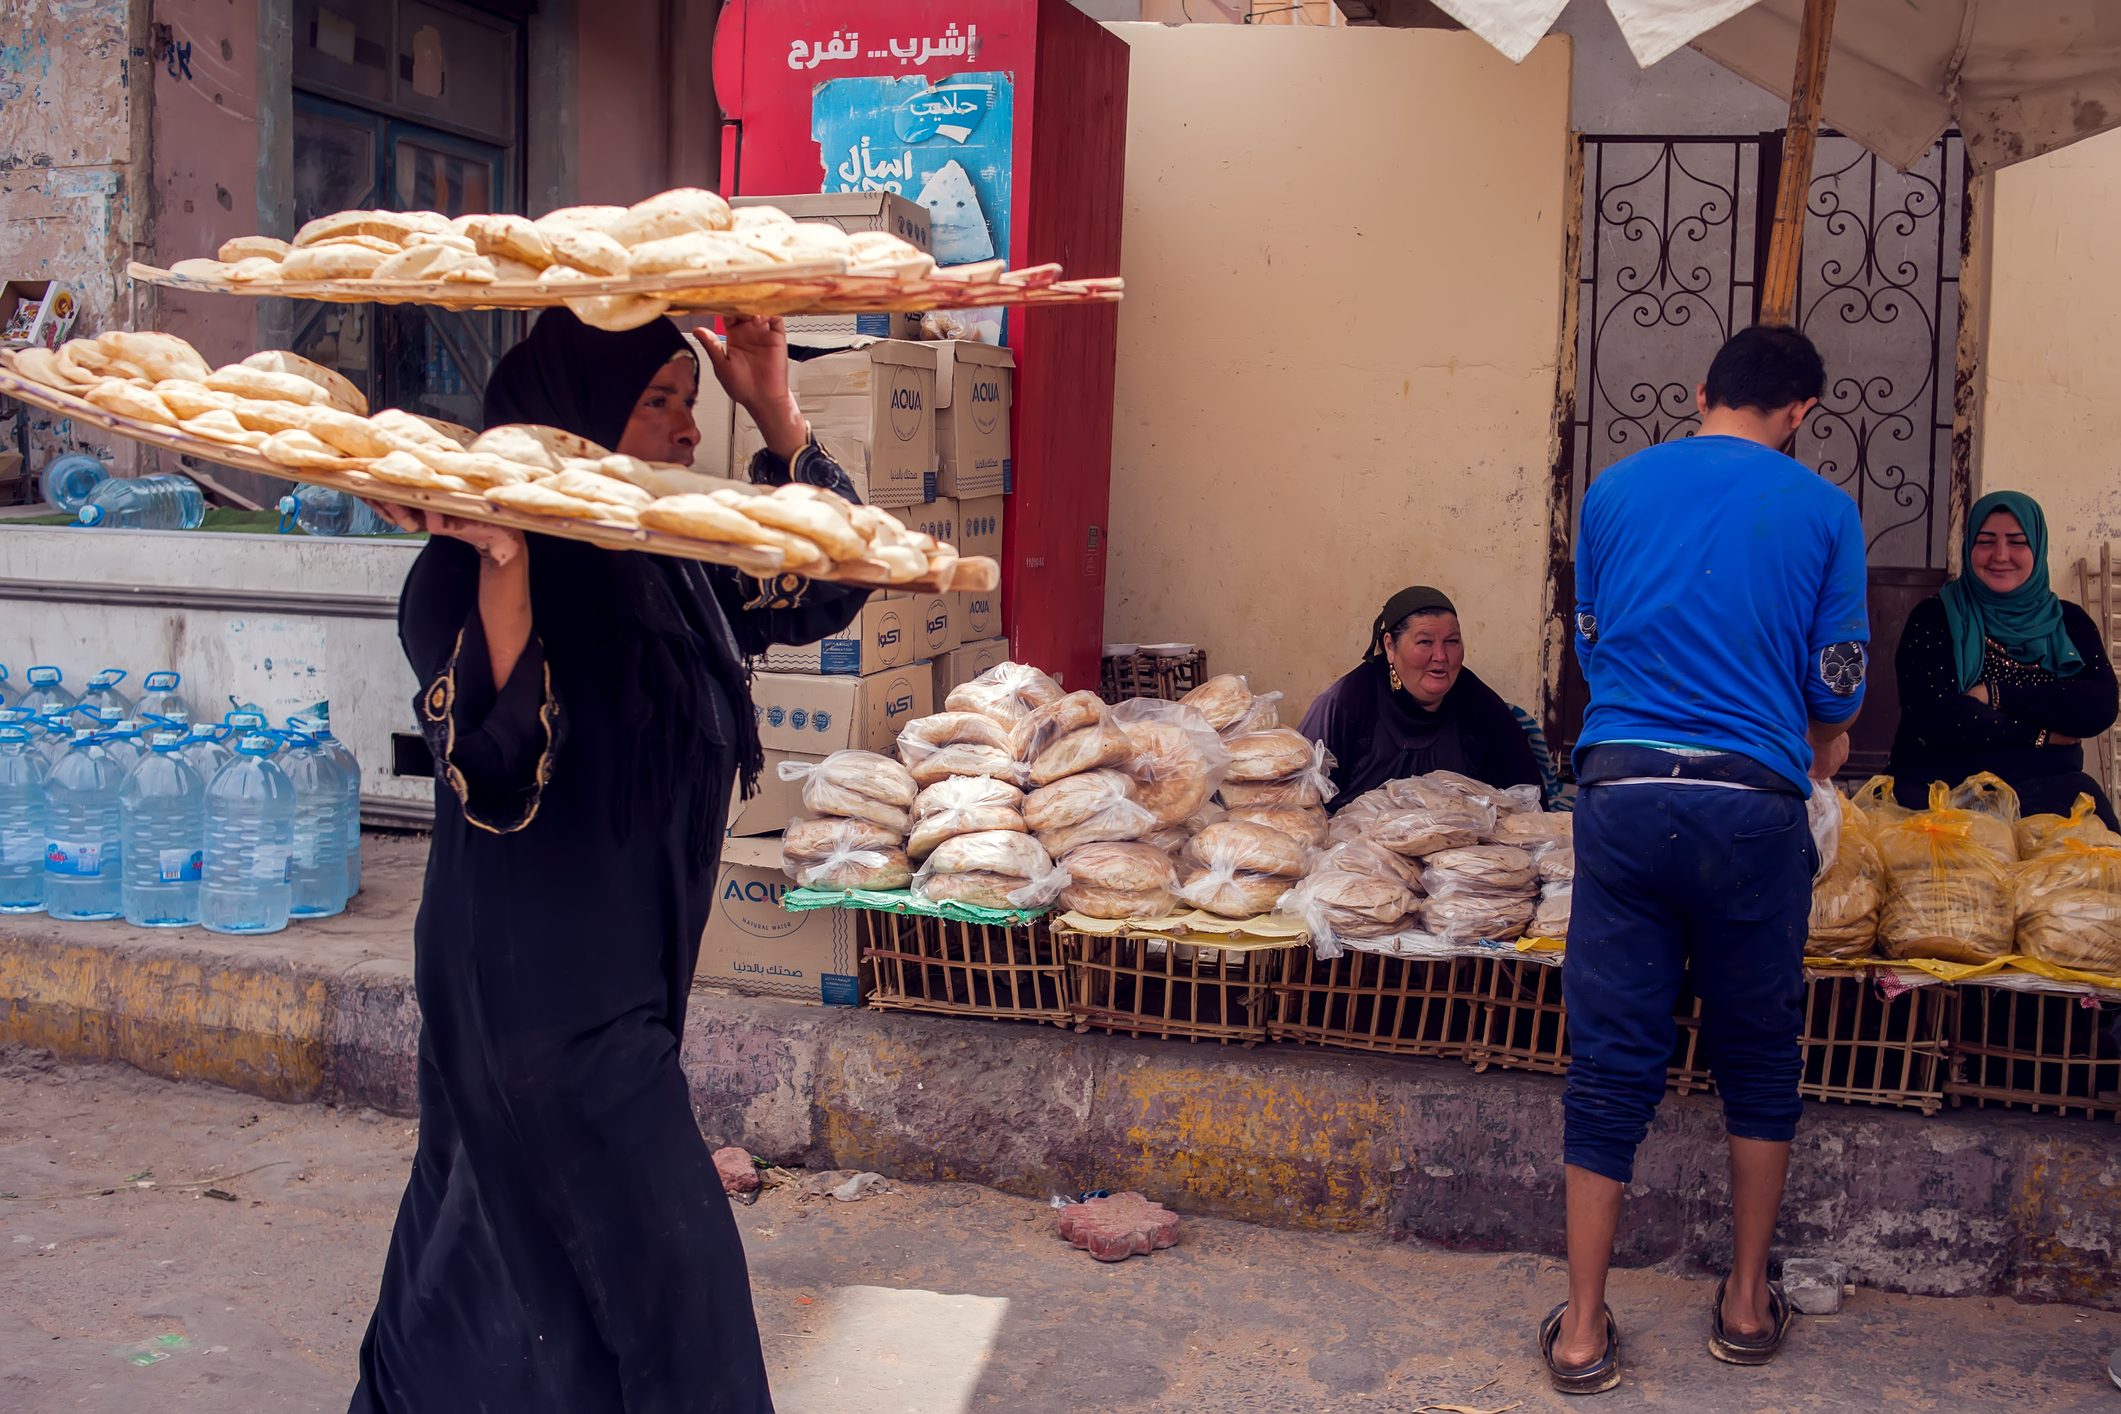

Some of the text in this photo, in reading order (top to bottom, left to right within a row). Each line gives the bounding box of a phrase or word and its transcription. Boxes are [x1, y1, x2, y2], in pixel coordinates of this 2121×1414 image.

[787, 30, 859, 70] تفرح
[891, 388, 922, 411] AQUA
[971, 382, 1000, 402] AQUA
[969, 600, 990, 614] AQUA
[723, 879, 800, 905] AQU
[742, 917, 792, 931] NATURAL WATER
[732, 960, 804, 978] صحتك بالدنيا
